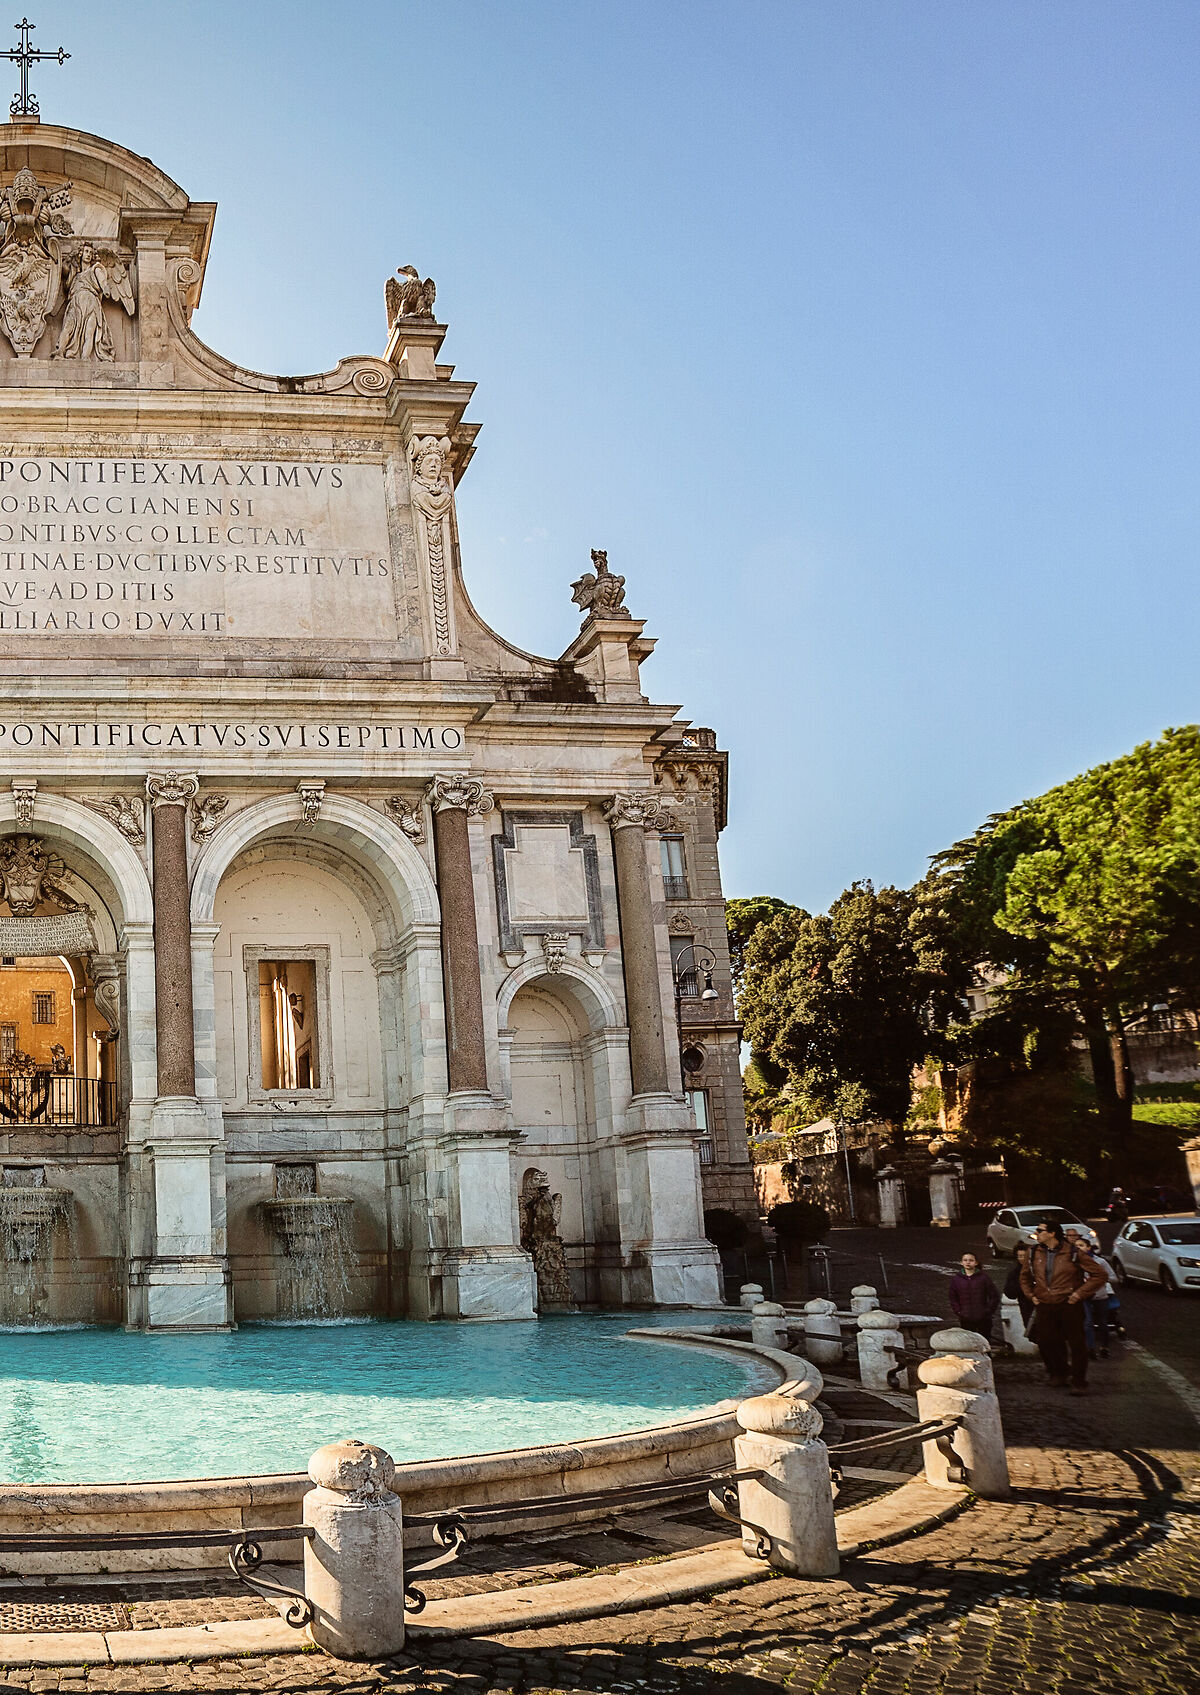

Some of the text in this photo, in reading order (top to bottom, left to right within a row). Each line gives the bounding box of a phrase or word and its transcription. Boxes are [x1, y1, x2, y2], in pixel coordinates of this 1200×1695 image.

[179, 463, 343, 489] MAXIMVS
[27, 496, 254, 517] BRACCIANENSI
[125, 524, 307, 546] COLLECTAM
[96, 552, 227, 574] DVCTIBVS
[234, 555, 389, 578] RESTITVTIS
[49, 581, 174, 601] ADDITIS
[135, 611, 226, 632] DVXIT
[258, 725, 307, 748] SVI
[318, 725, 462, 750] SEPTIMO
